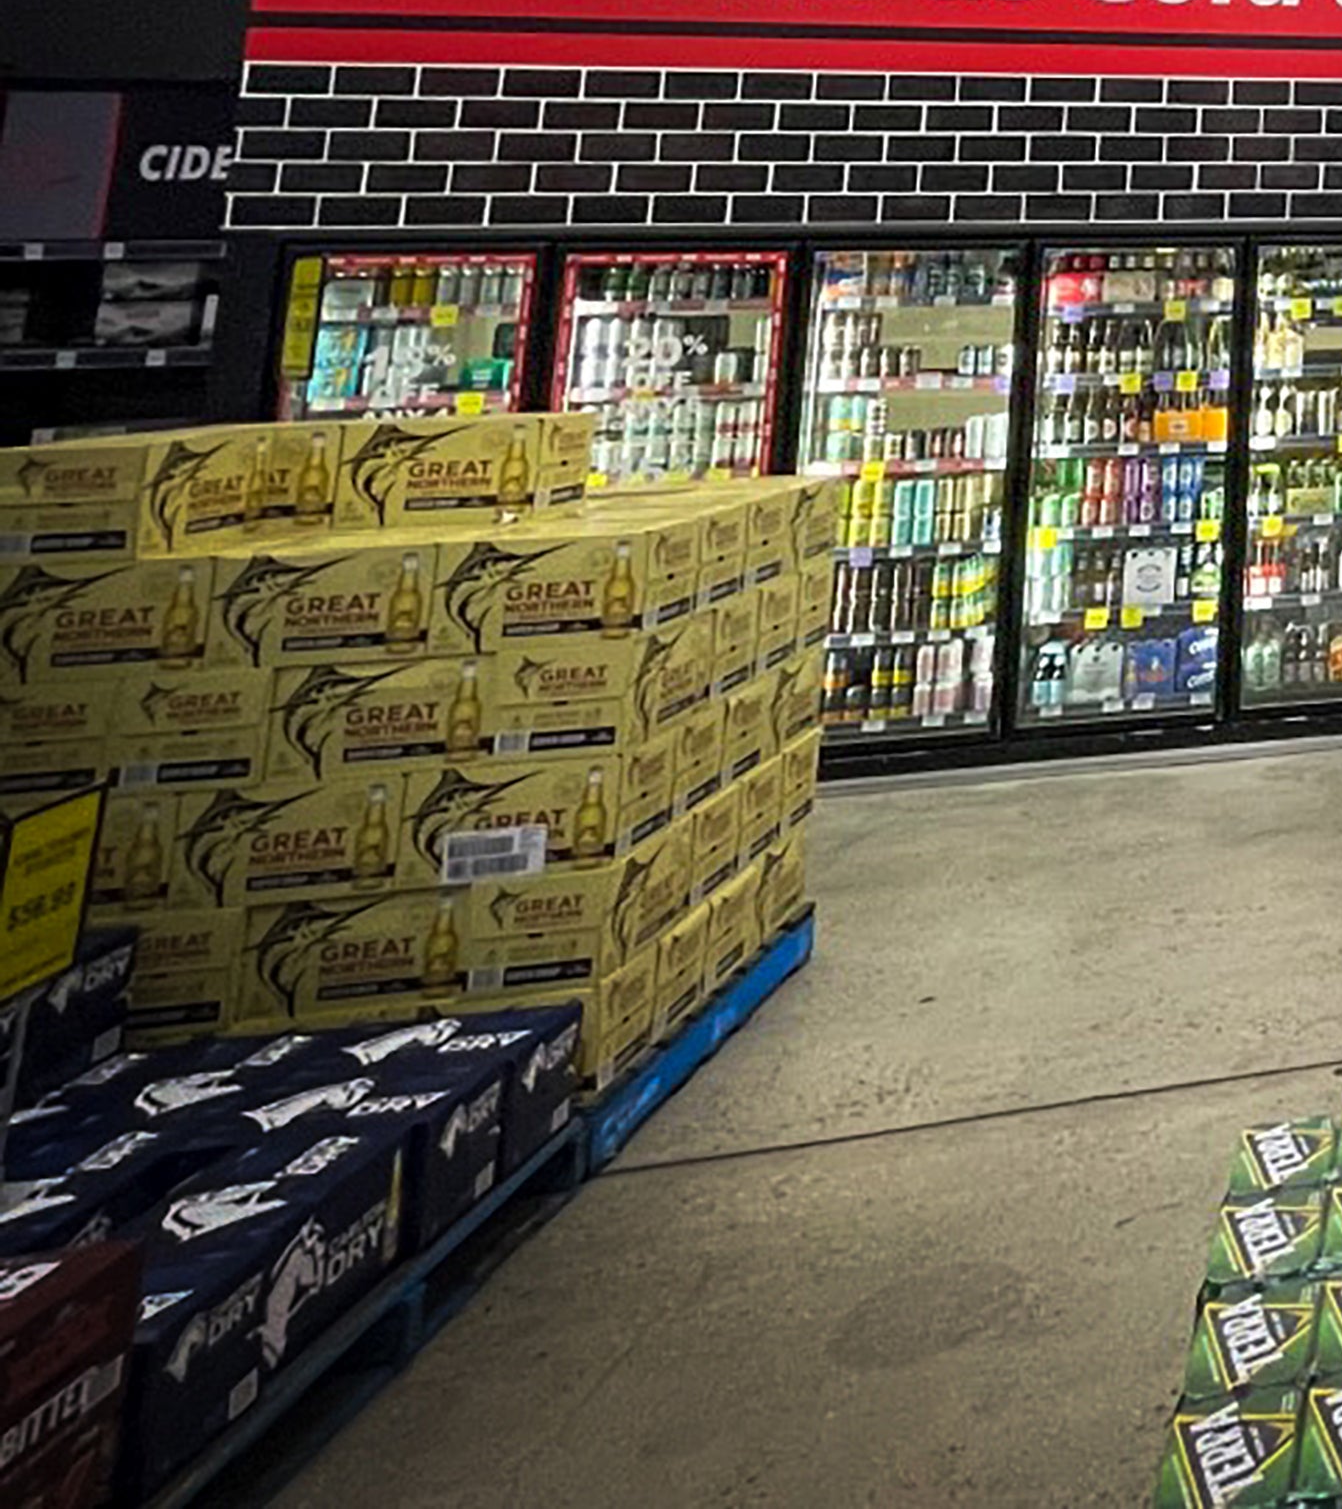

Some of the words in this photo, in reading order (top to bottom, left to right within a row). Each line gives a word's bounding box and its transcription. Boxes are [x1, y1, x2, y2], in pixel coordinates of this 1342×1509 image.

[621, 334, 709, 370] 20%
[407, 458, 494, 479] GREAT
[405, 476, 493, 491] NORTHERN
[505, 579, 597, 602] GREAT
[285, 592, 382, 617] GREAT
[504, 597, 596, 615] NORTHERN
[54, 605, 156, 630] GREAT
[282, 612, 381, 629] NORTHERN
[51, 626, 154, 643] NORTHERN
[539, 665, 608, 683] GREAT
[344, 702, 441, 726] GREAT
[250, 826, 349, 853] GREAT
[515, 894, 585, 915] GREAT
[318, 936, 418, 963] GREAT
[438, 1028, 535, 1053] DRY
[347, 1090, 452, 1118] DRY
[1253, 1123, 1310, 1188] TERRA
[1234, 1198, 1296, 1277] TERRA
[325, 1221, 386, 1287] DRY
[207, 1293, 263, 1348] DRY
[1218, 1293, 1284, 1389] TERRA
[1190, 1402, 1264, 1508] TERRA
